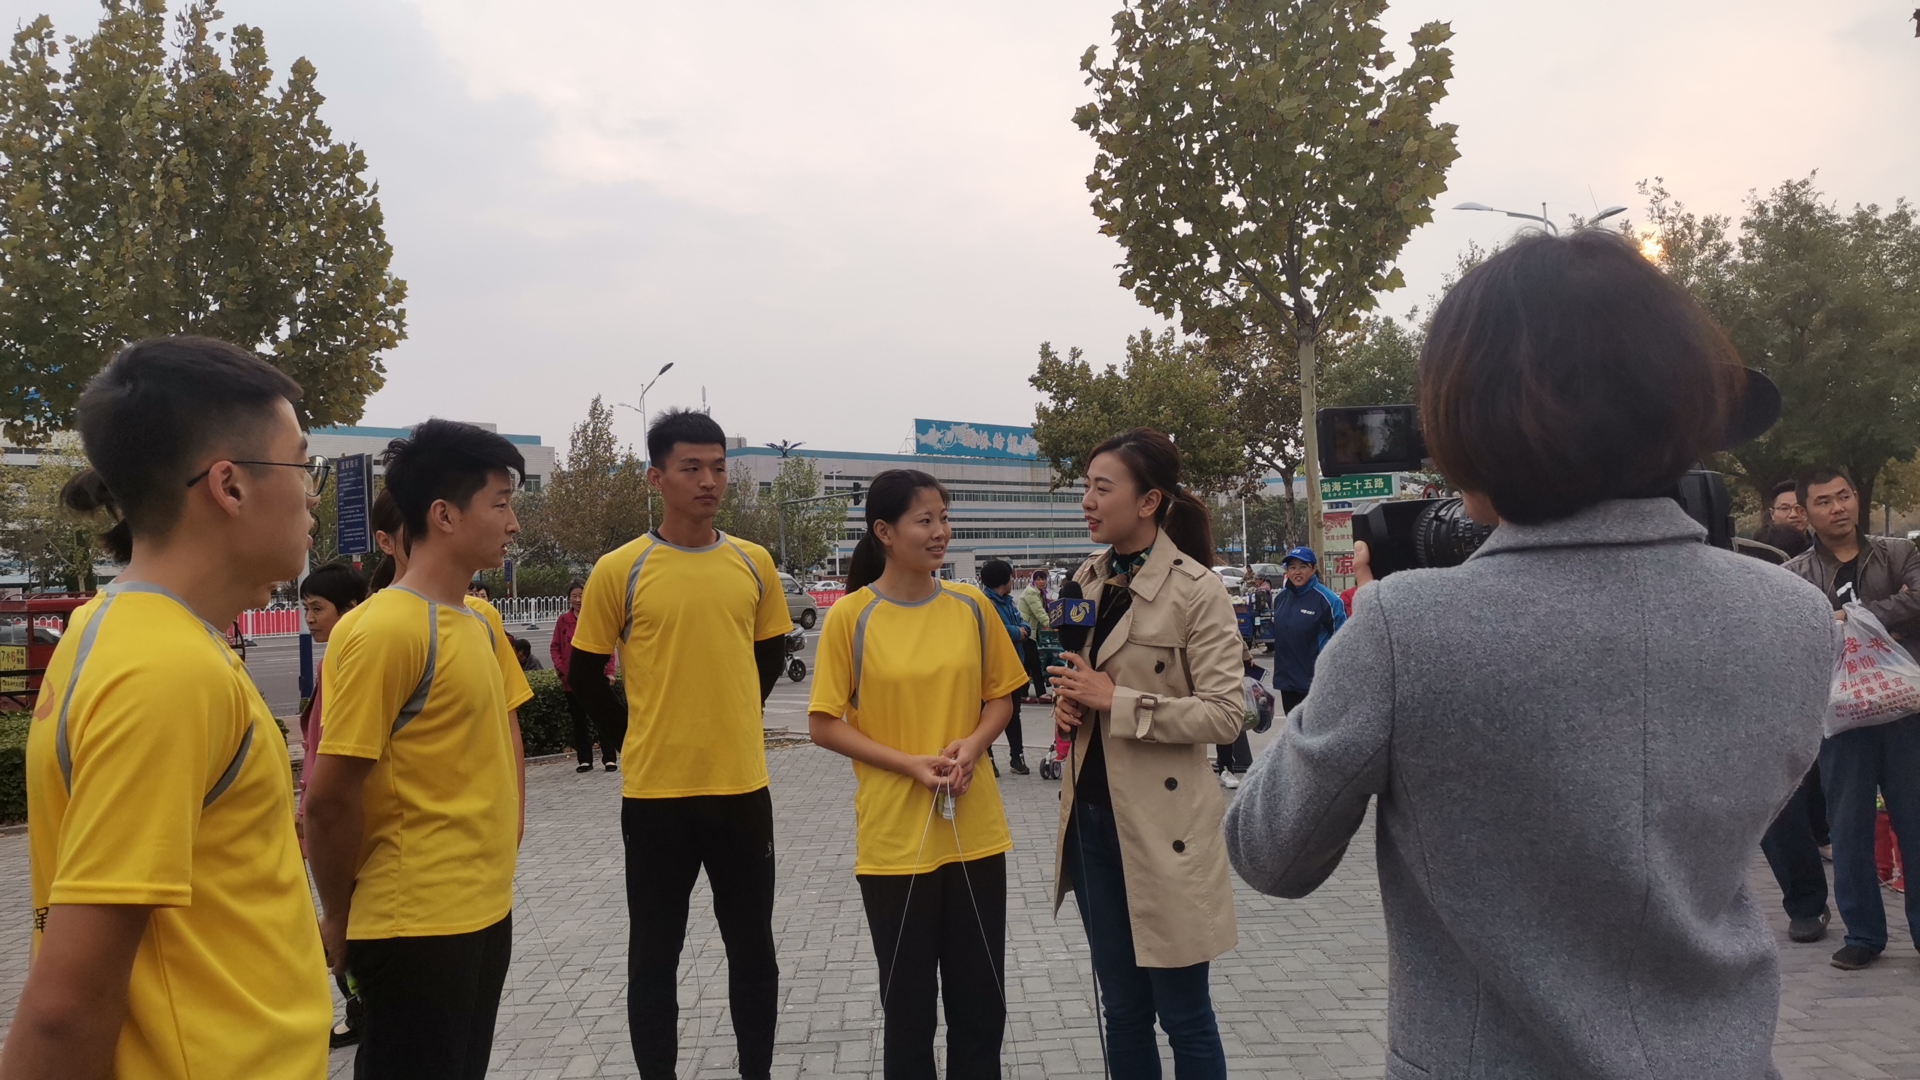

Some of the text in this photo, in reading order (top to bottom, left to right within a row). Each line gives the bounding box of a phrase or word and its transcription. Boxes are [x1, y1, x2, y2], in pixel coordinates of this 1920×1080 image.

[1321, 478, 1384, 493] 渤海二十五路
[1840, 671, 1885, 691] 无以回报
[1853, 677, 1906, 700] 就是便宜
